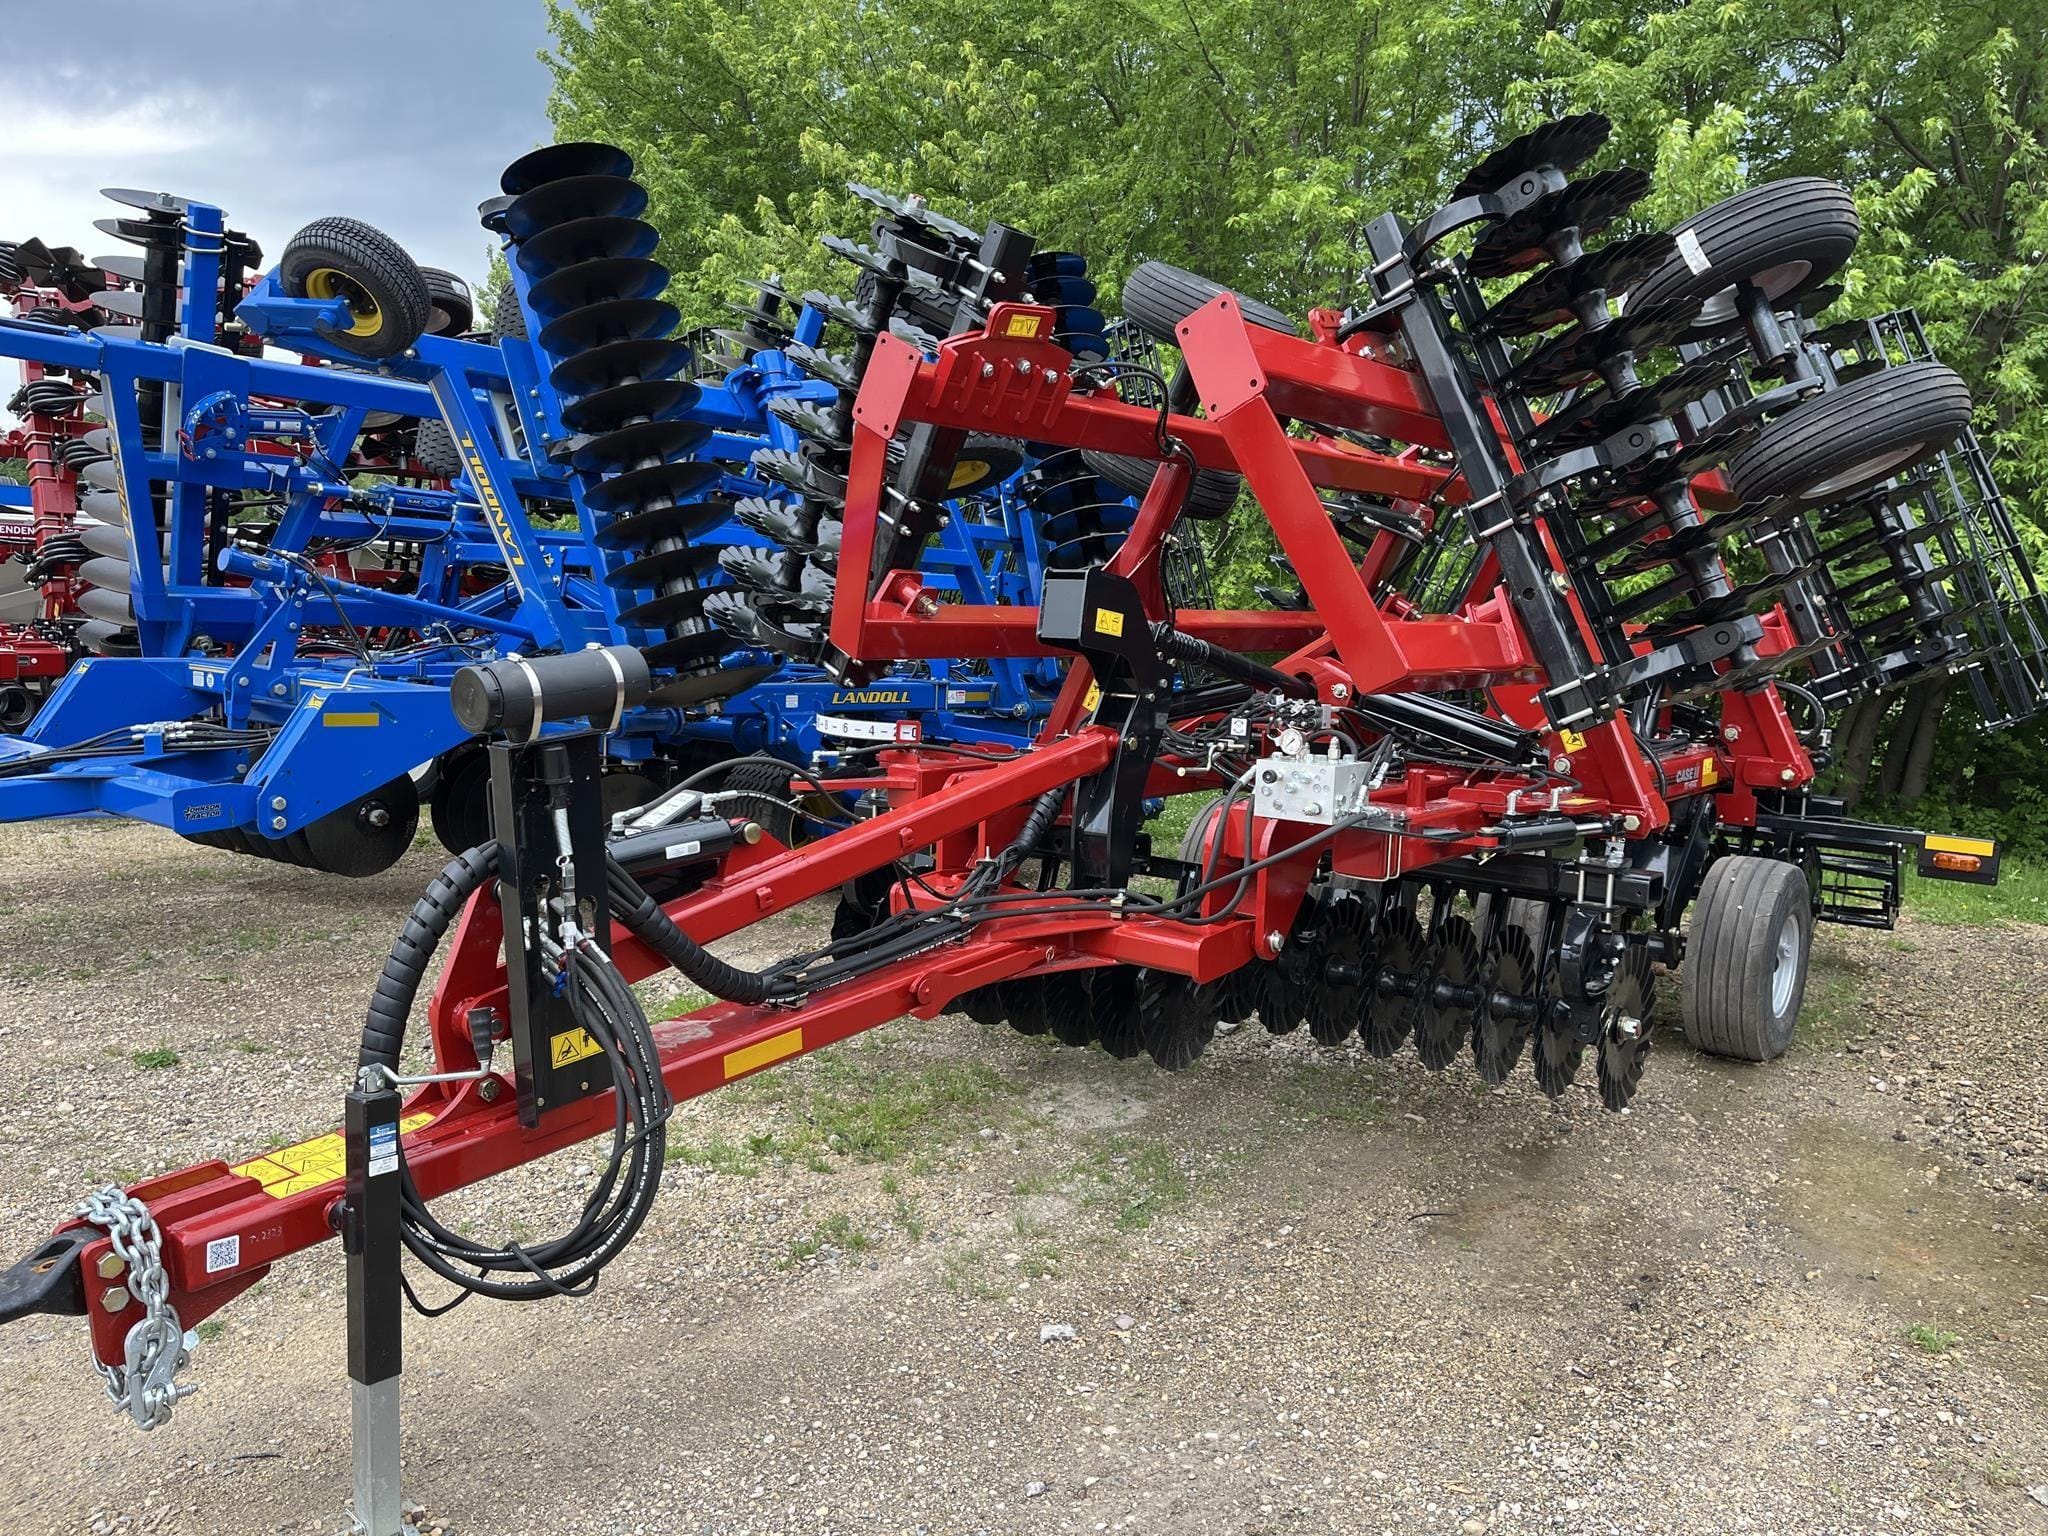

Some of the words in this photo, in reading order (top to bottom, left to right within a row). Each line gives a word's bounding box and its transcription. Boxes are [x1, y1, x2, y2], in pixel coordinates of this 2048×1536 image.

[461, 430, 525, 566] LANDOLL
[832, 691, 911, 705] LANDOLL
[869, 725, 875, 736] 4
[1676, 767, 1695, 783] CASE
[184, 803, 221, 813] JOHNSON
[184, 810, 221, 821] TRACTOR
